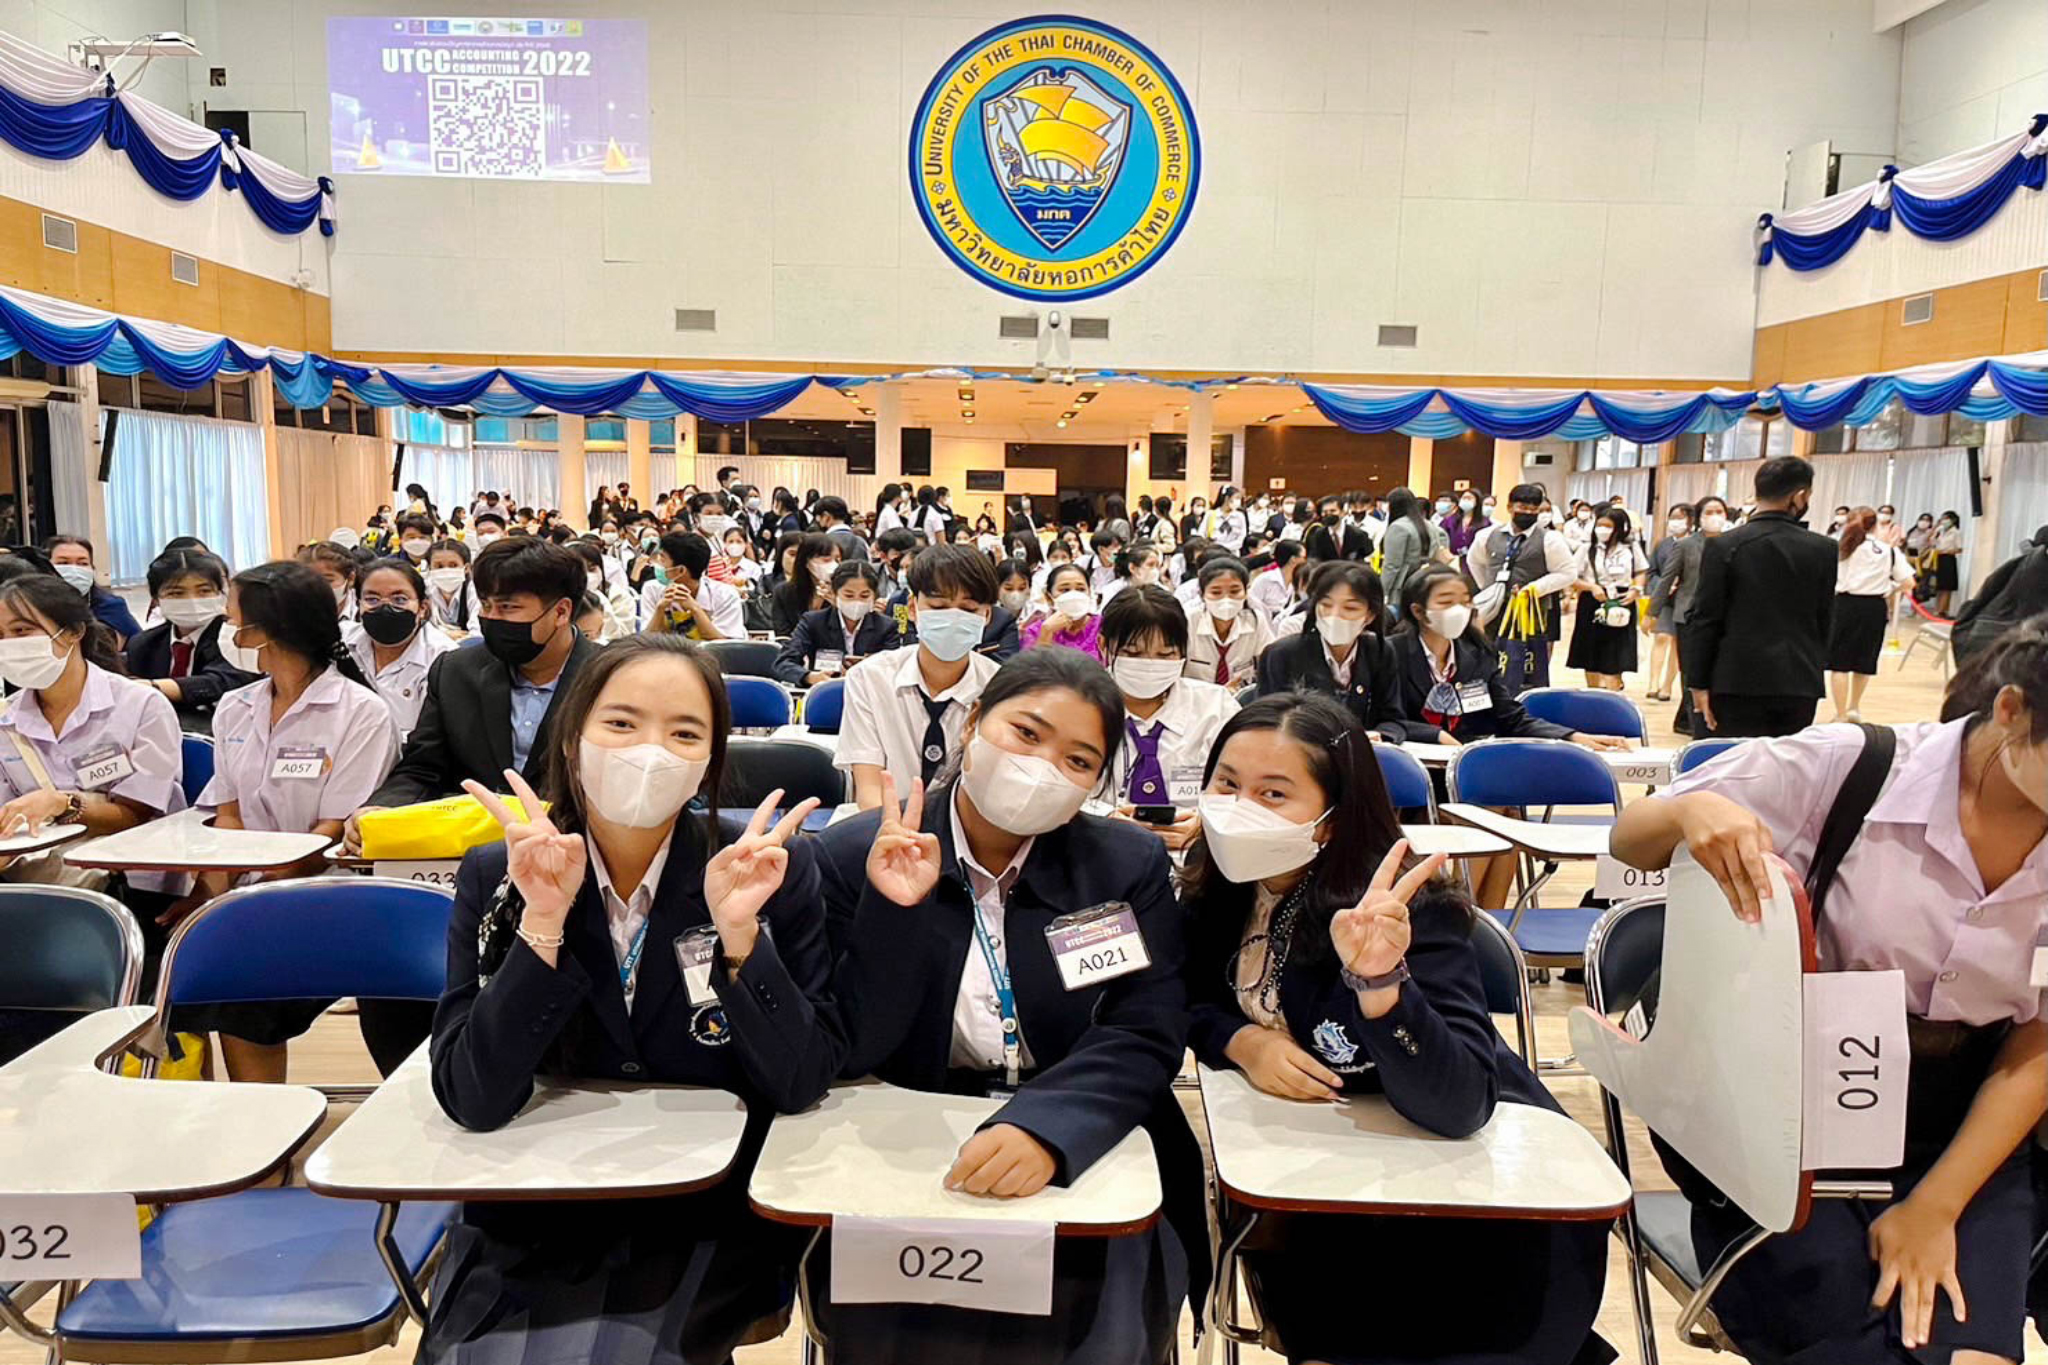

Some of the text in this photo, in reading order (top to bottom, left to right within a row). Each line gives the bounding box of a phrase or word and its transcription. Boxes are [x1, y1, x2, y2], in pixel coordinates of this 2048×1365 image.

[381, 47, 592, 77] UTCC ACCOUNTING 2022
[452, 62, 520, 76] COMPETITION
[925, 34, 1182, 184] UNIVERSITY OF THE THAI CHAMBER OF COMMERCE
[89, 761, 119, 782] A057
[280, 763, 312, 774] A057
[1626, 766, 1657, 779] 003
[1177, 785, 1199, 796] A01
[1623, 868, 1665, 887] 013
[1079, 945, 1129, 976] A021
[1837, 1035, 1880, 1110] 012
[0, 1224, 72, 1260] 32
[899, 1244, 984, 1284] 022
